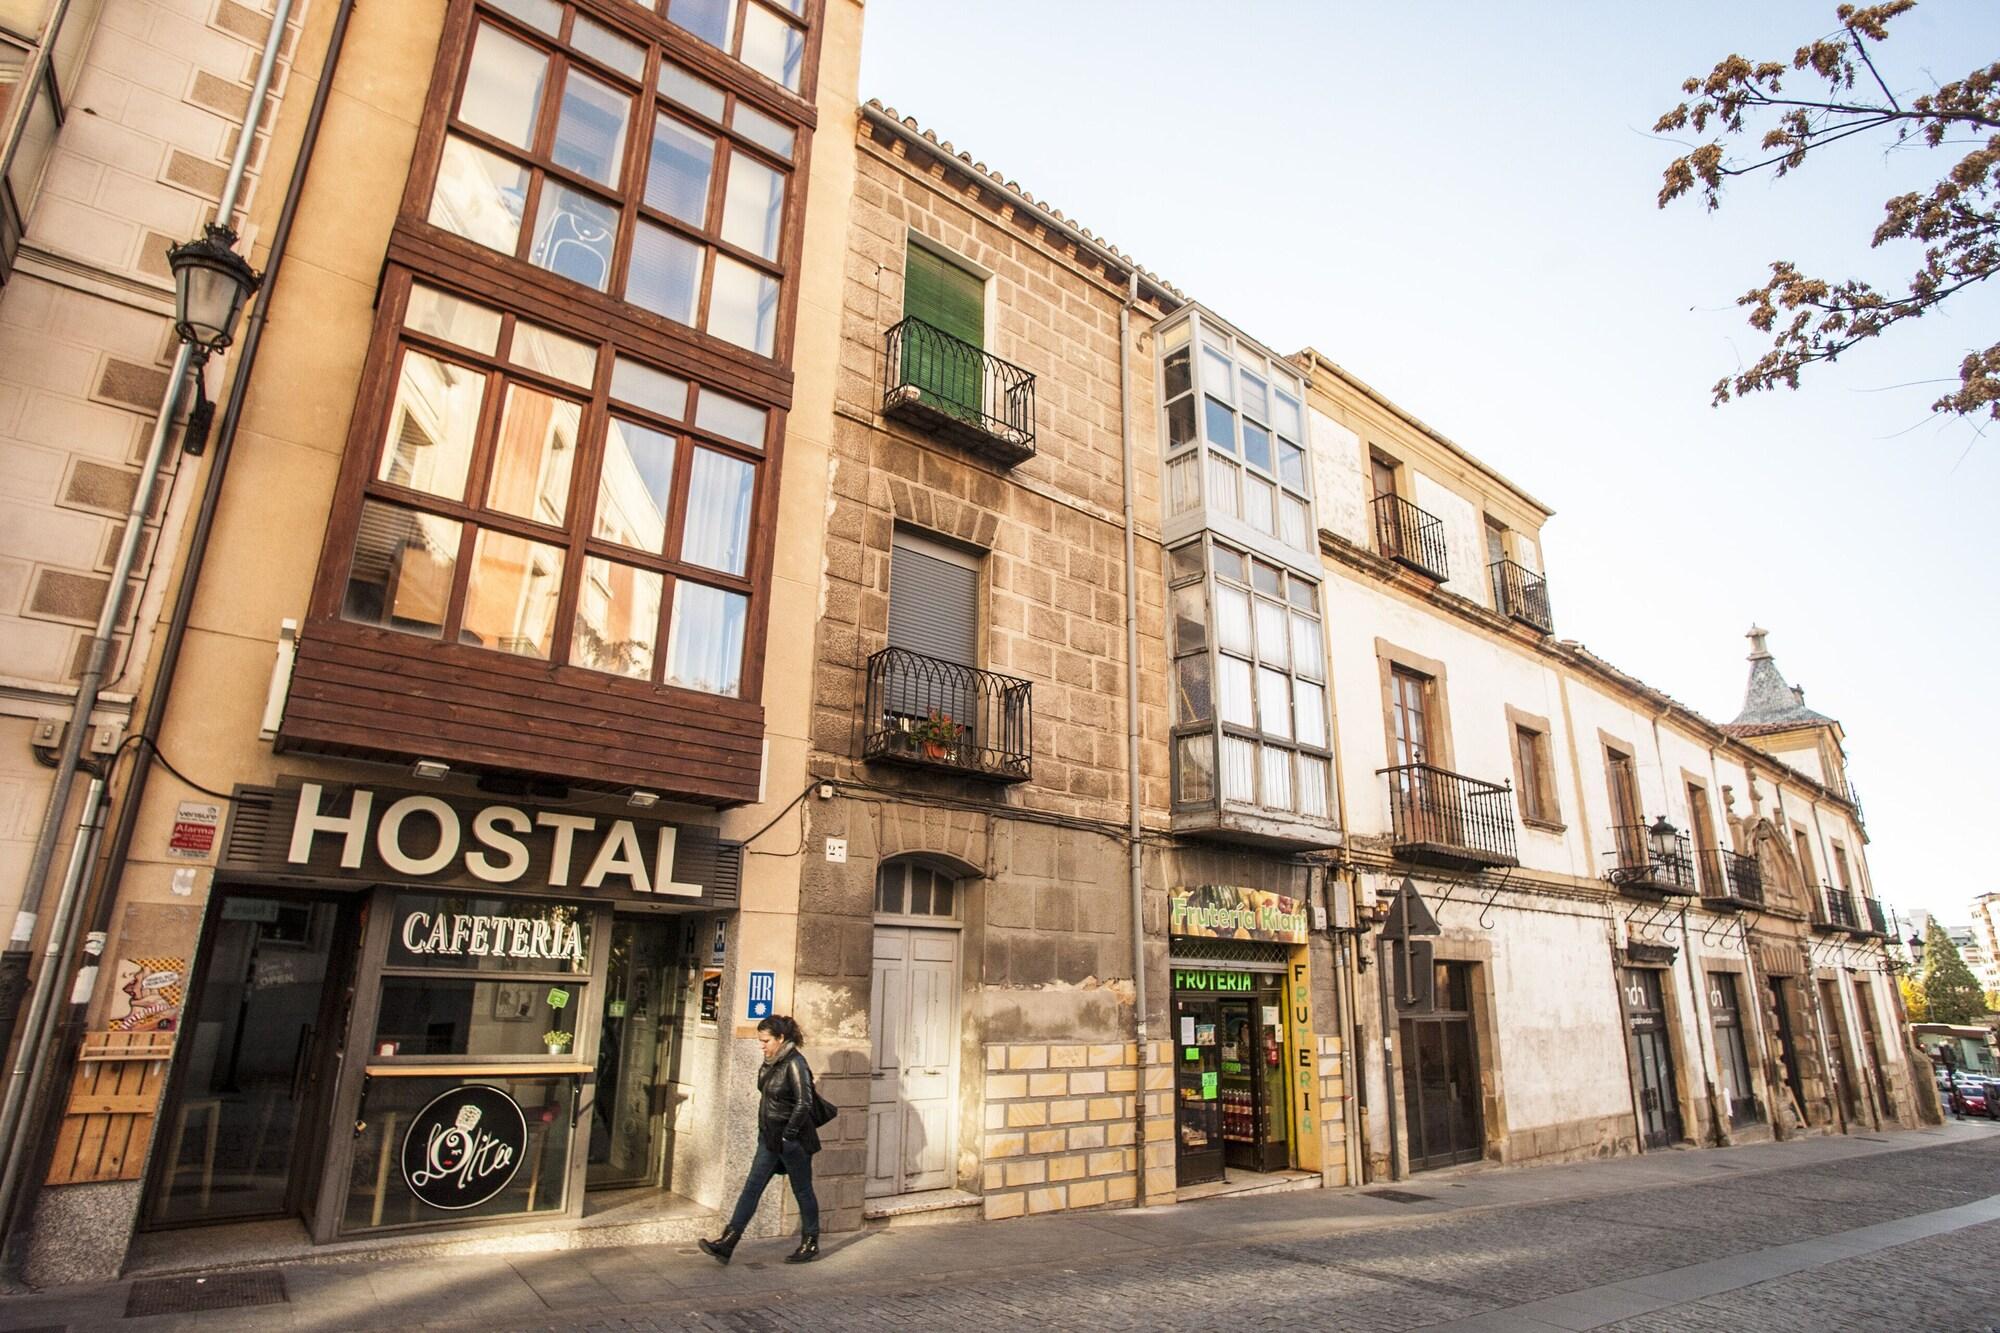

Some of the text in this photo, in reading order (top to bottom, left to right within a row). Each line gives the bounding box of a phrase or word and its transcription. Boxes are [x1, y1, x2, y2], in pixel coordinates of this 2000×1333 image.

[175, 823, 214, 835] Alarma
[287, 783, 703, 897] HOSTAL
[1171, 897, 1257, 930] Frutería
[402, 911, 584, 960] CAFETERIA
[750, 975, 772, 1001] HR
[1175, 971, 1252, 991] FRUTERIA
[1294, 964, 1313, 1135] FRUTERIA
